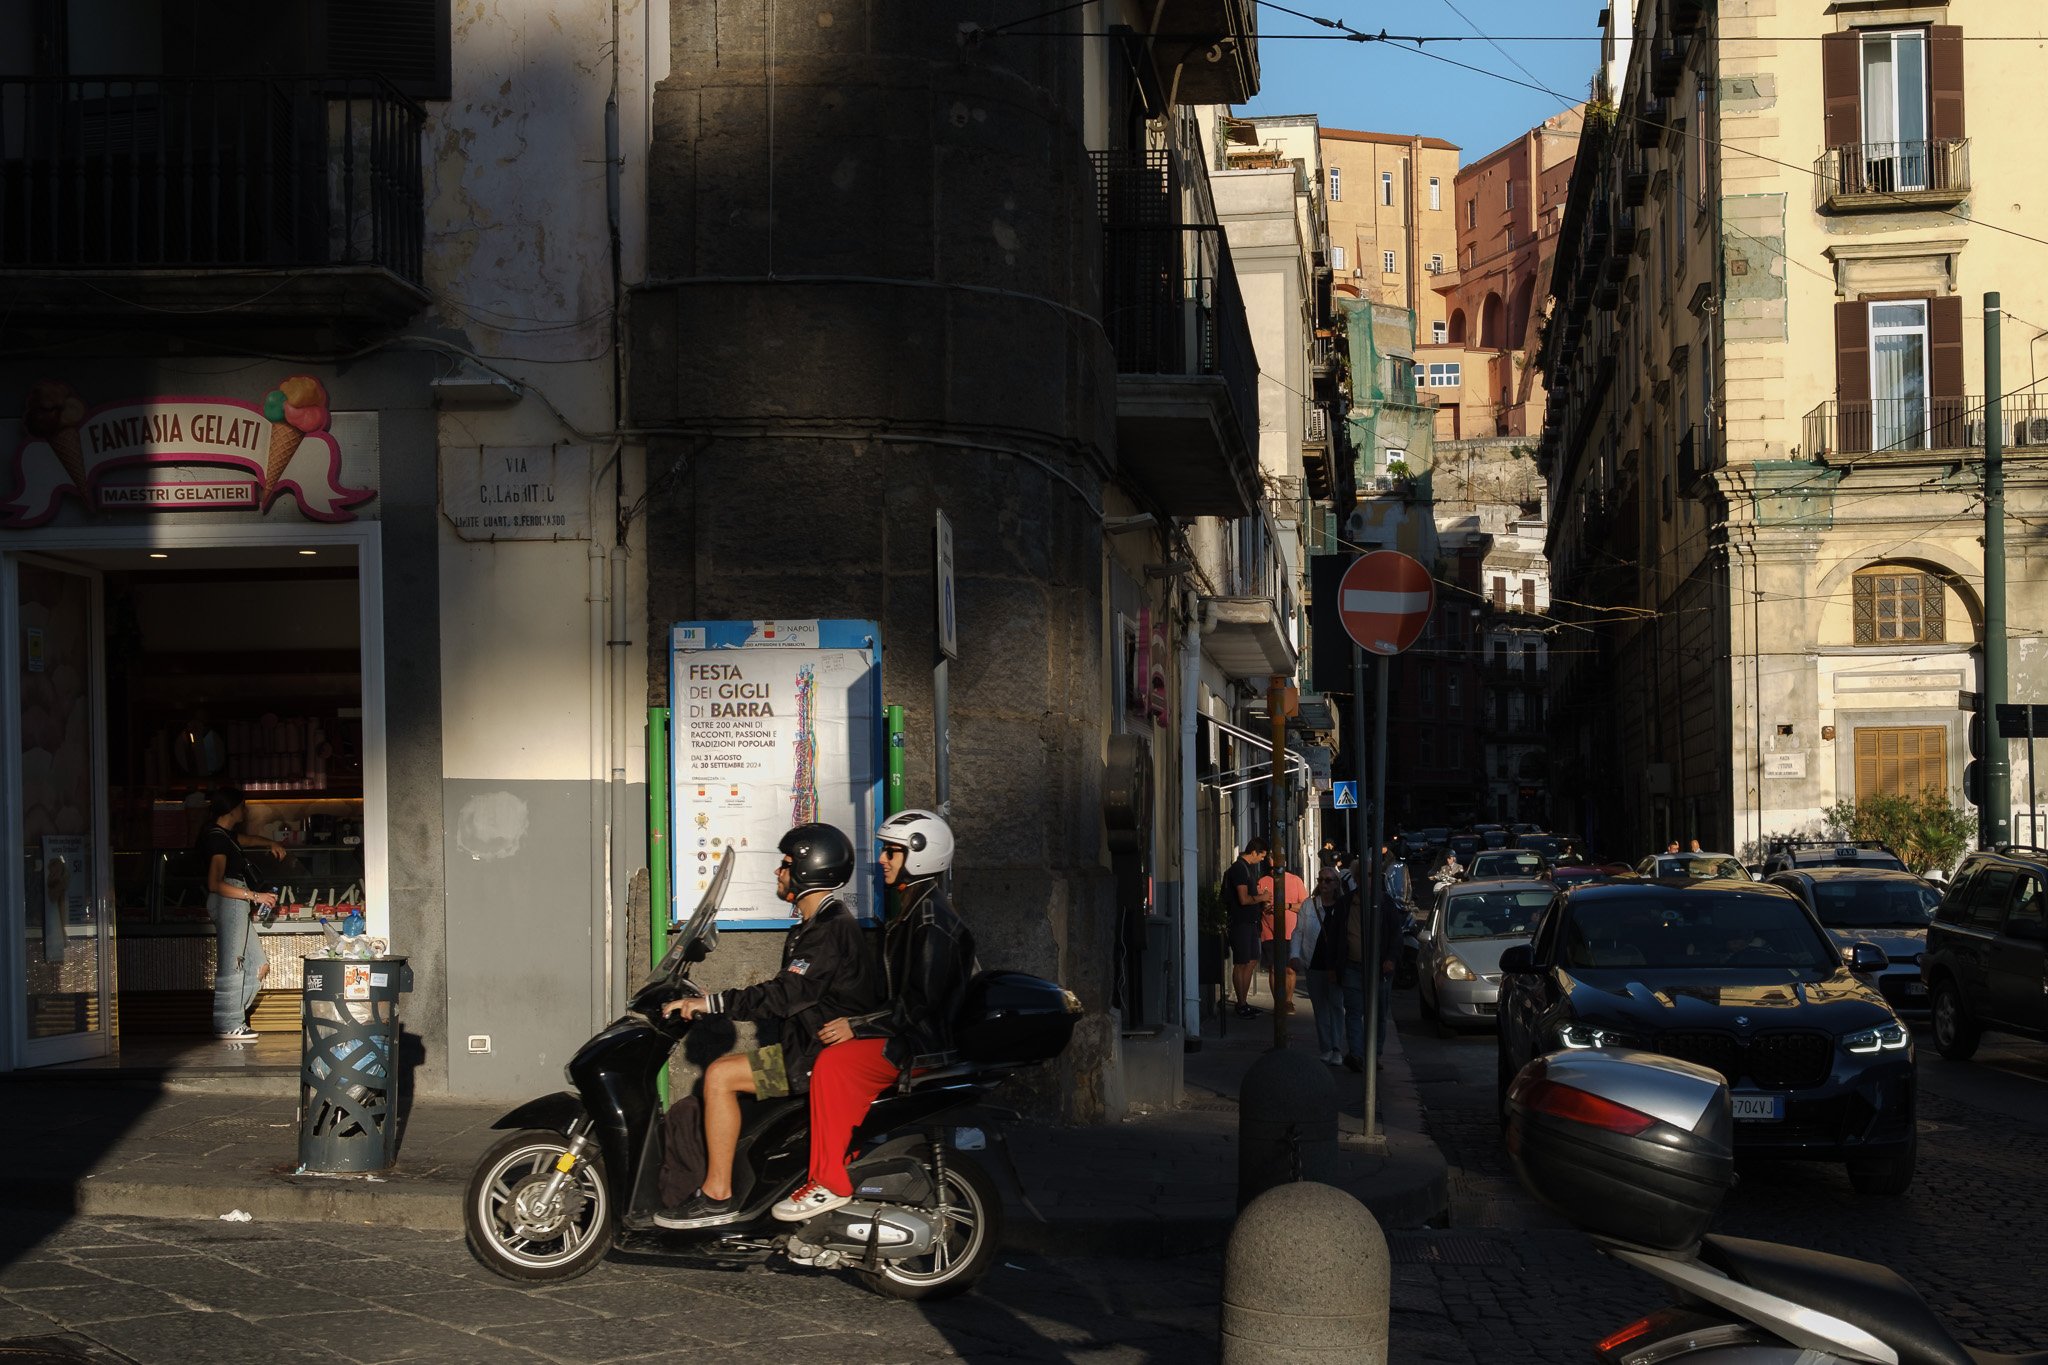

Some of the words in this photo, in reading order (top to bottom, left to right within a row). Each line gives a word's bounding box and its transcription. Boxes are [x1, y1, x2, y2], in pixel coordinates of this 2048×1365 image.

[88, 413, 183, 454] FANTASIA
[191, 414, 261, 450] GELATI
[506, 457, 528, 473] VIA
[104, 488, 169, 501] MAESTRI
[174, 487, 249, 500] GELATIERI
[787, 624, 815, 632] NAPOLI
[689, 664, 743, 680] FESTA
[689, 686, 712, 699] DEI
[718, 683, 769, 699] GIGLI
[690, 705, 704, 718] DI
[710, 702, 774, 718] BARRA
[690, 721, 714, 729] OLTRE
[716, 721, 731, 729] 200
[732, 721, 753, 729] ANNI
[755, 721, 763, 729] DI
[690, 731, 734, 739] RACCONTI,
[735, 730, 771, 738] PASSIONI
[691, 740, 736, 748] TRADIZIONI
[737, 740, 776, 748] POPOLARI
[1837, 848, 1856, 856] TAXI
[1737, 1100, 1773, 1114] 704VJ
